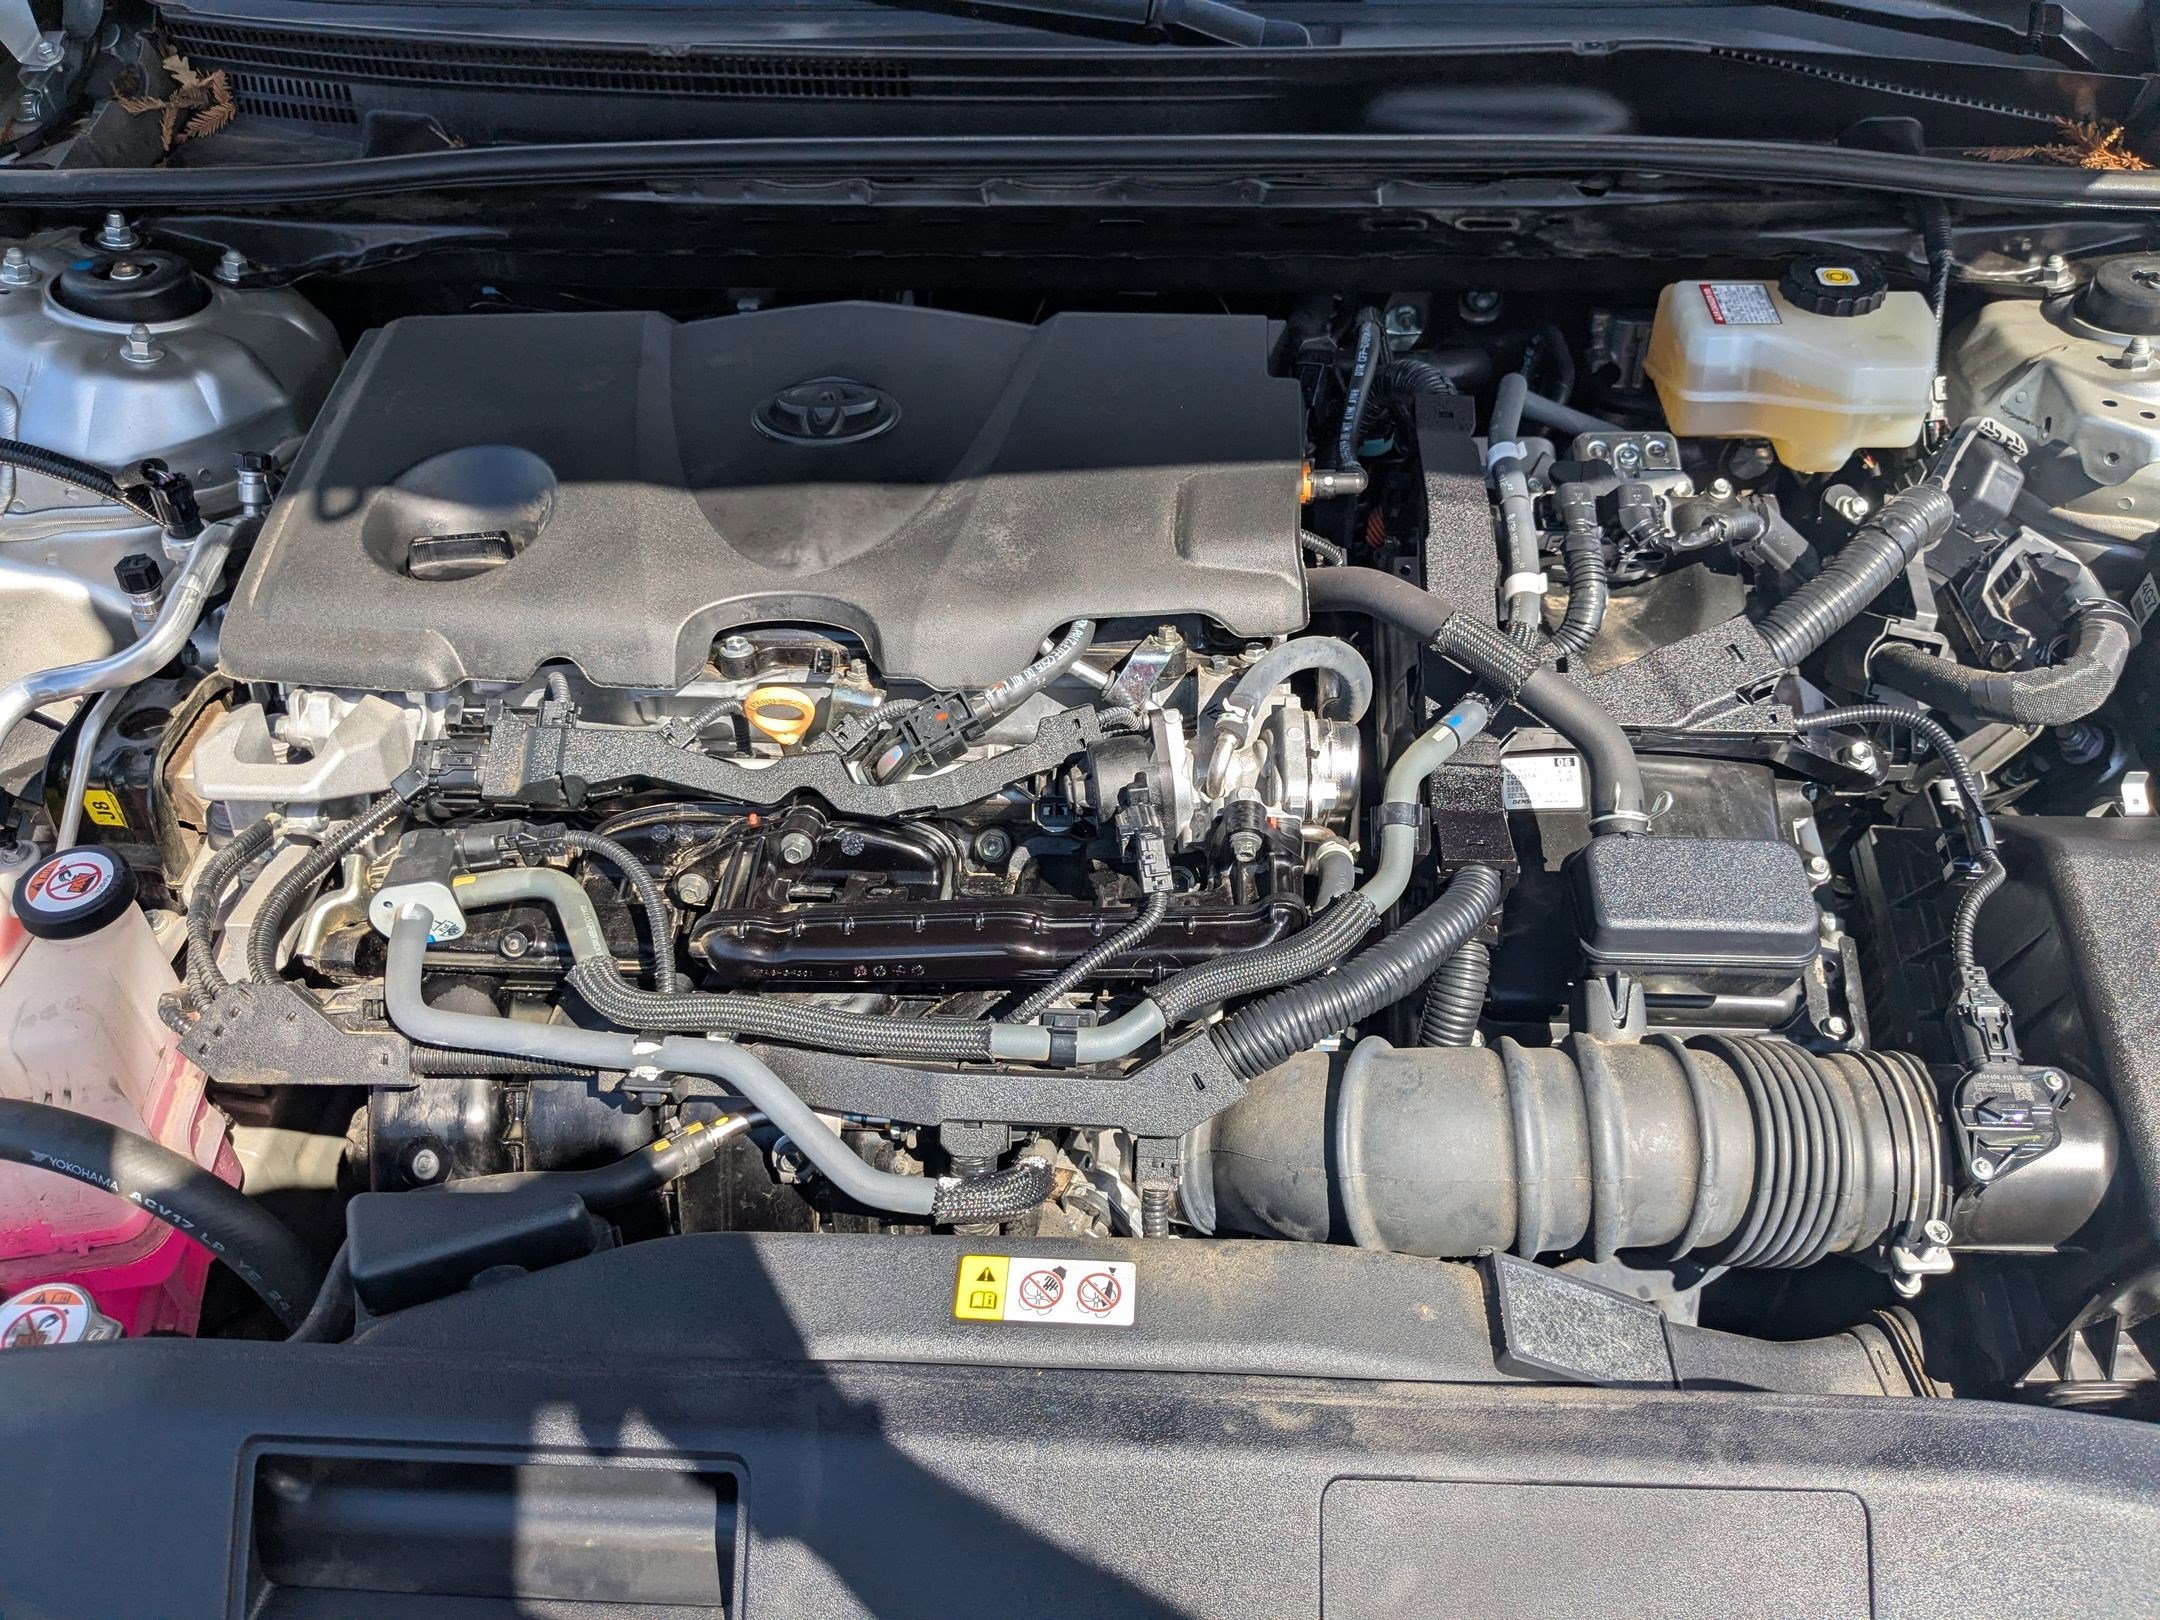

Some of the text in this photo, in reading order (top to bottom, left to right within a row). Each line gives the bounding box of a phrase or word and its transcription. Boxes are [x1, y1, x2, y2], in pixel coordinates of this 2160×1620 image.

[1556, 758, 1572, 767] 06
[92, 801, 116, 820] J8
[49, 1156, 120, 1192] YOKOHAMA
[128, 1191, 195, 1228] ACV17
[200, 1232, 226, 1252] LP
